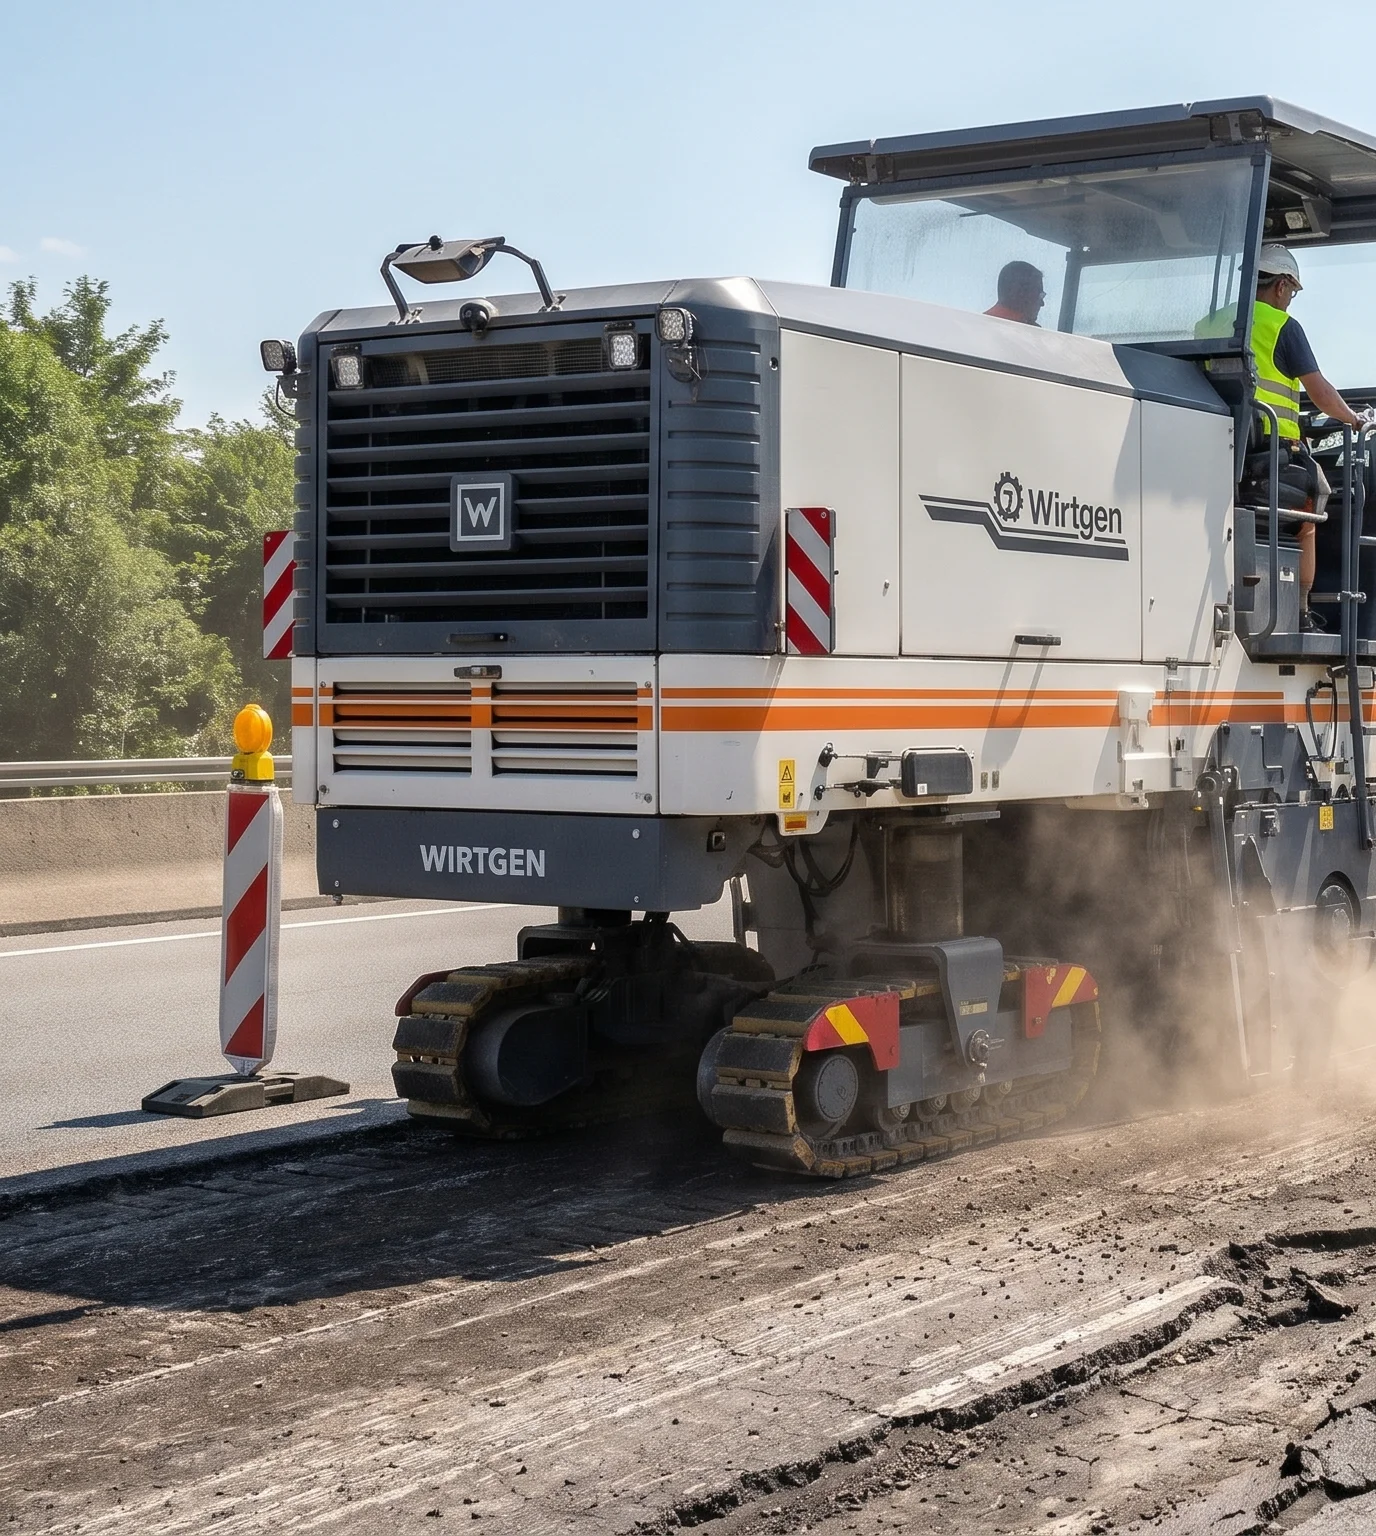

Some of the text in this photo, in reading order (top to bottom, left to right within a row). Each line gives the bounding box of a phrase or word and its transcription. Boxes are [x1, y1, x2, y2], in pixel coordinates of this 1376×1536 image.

[464, 497, 498, 528] W
[1027, 488, 1122, 540] Wirtgen
[419, 844, 546, 878] WIRTGEN
